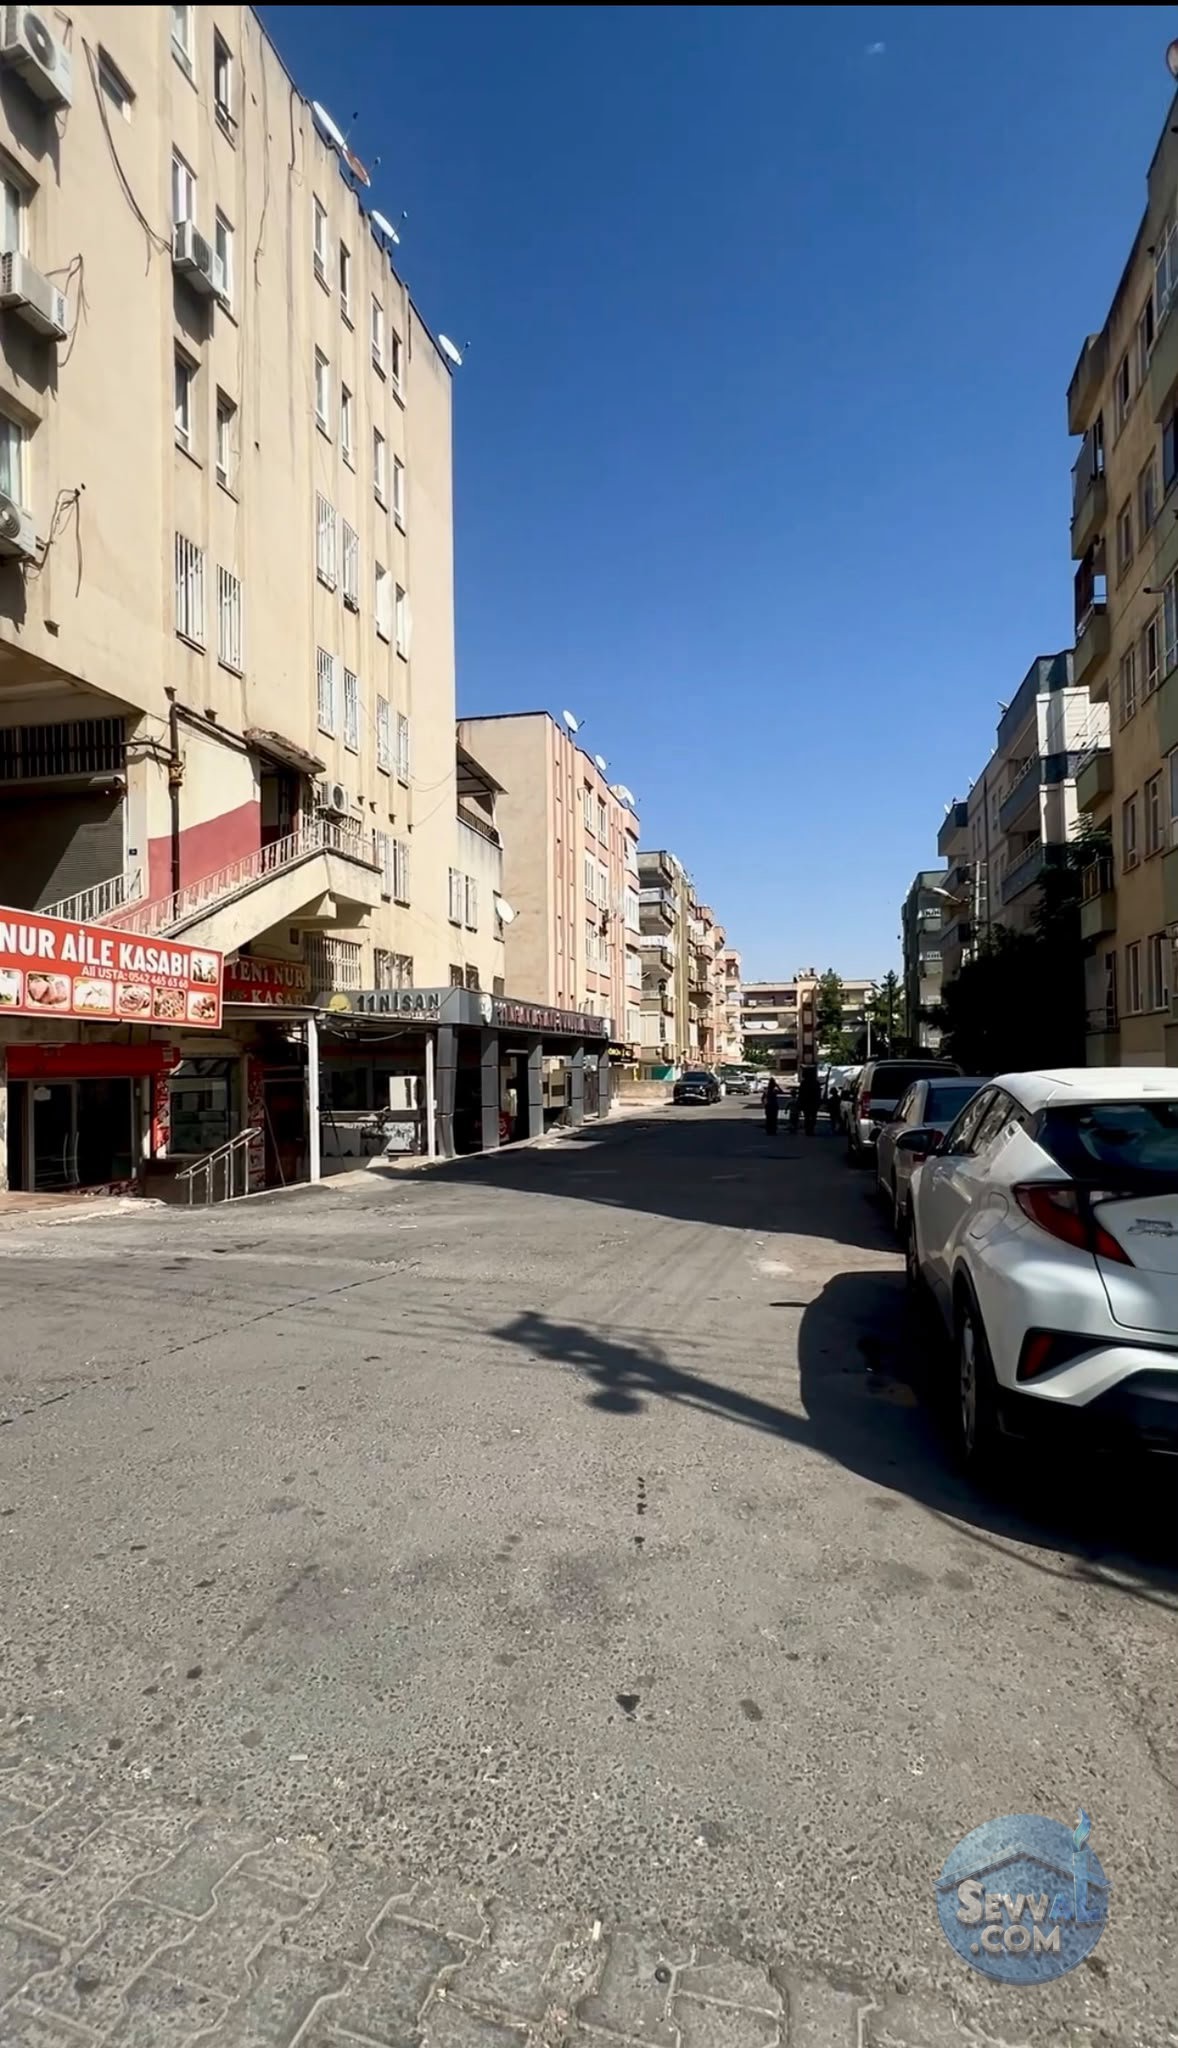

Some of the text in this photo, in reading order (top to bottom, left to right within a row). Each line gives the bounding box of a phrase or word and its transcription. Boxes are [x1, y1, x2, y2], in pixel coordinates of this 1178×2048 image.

[0, 922, 188, 978] NUR AİLE KASABI
[273, 967, 305, 988] NUR
